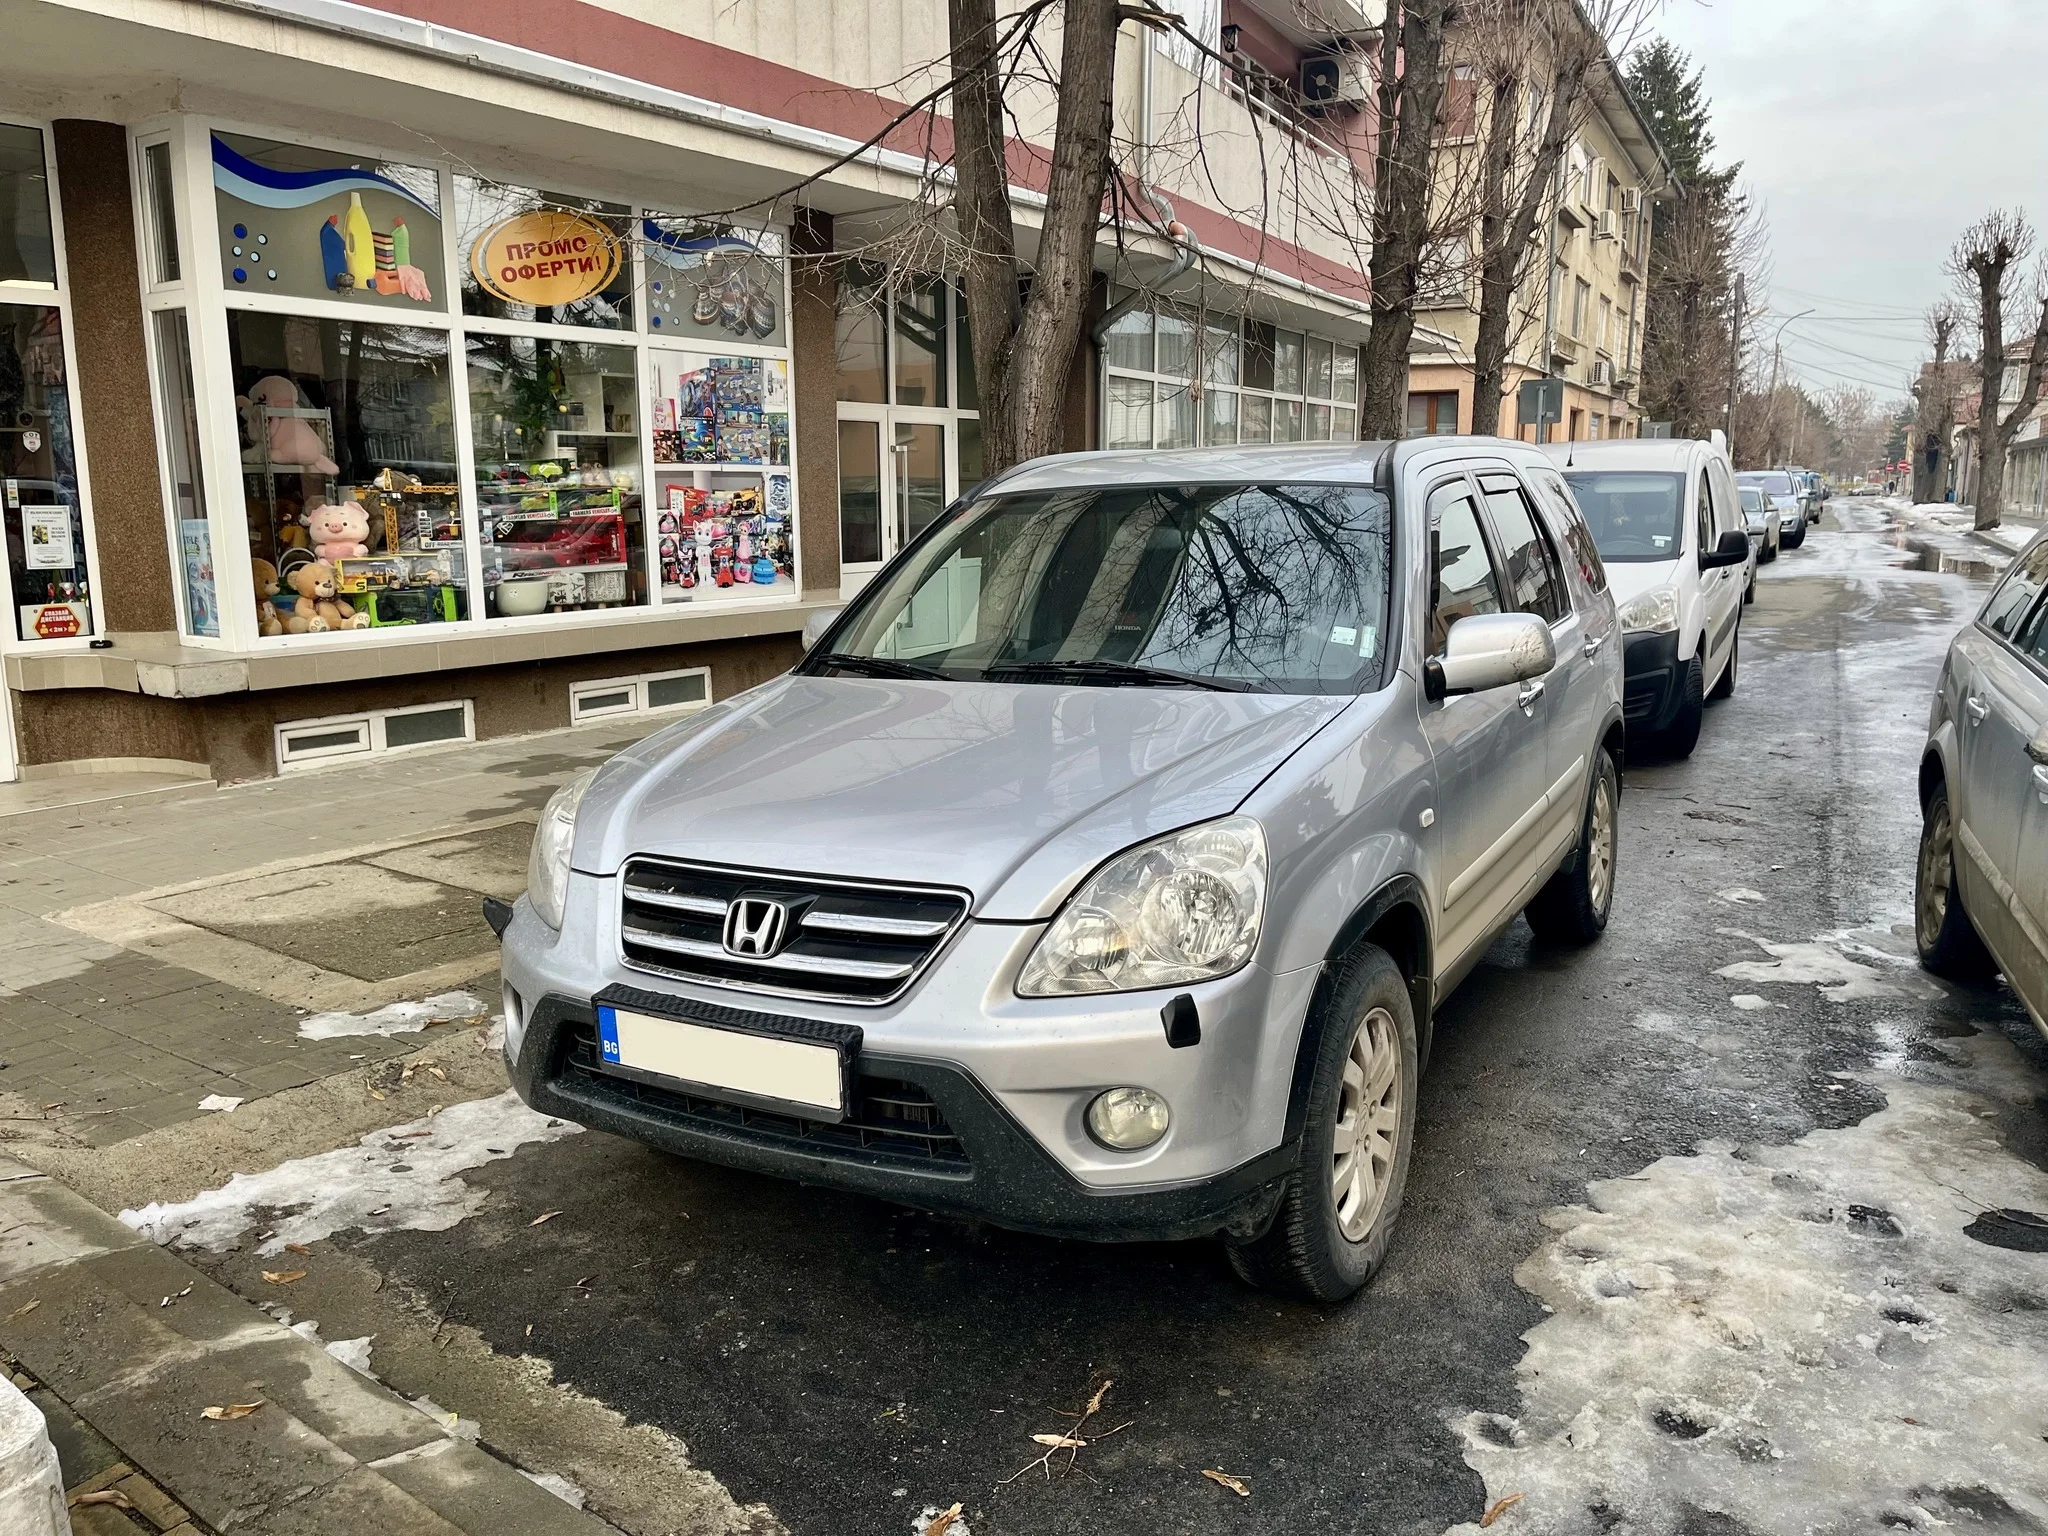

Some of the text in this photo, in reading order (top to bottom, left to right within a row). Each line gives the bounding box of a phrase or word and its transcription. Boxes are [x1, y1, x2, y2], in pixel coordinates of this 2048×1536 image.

[506, 236, 587, 261] ПРОМО
[501, 255, 601, 283] ОФЕРТИ!
[40, 615, 74, 623] ДИСТАНЦИЯ
[603, 1039, 619, 1055] BG
